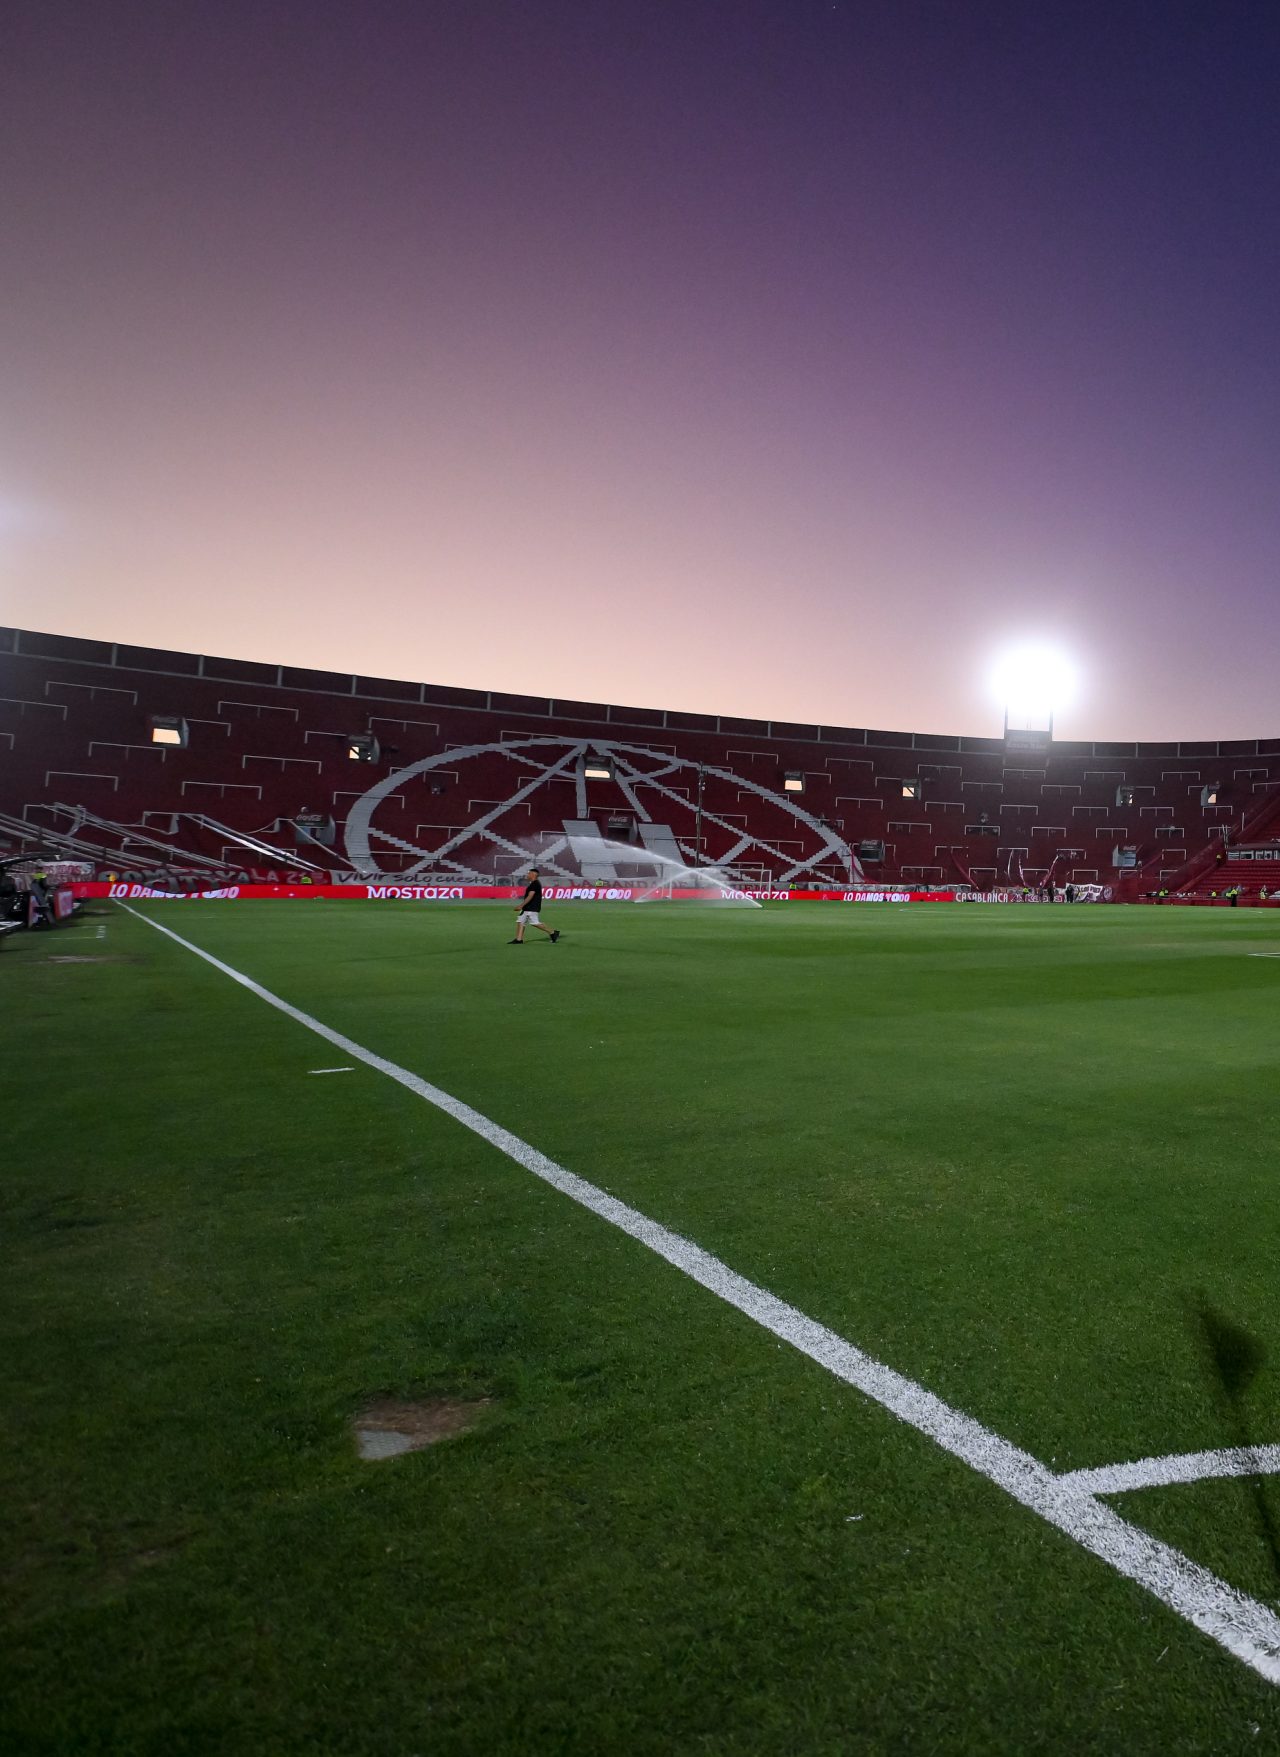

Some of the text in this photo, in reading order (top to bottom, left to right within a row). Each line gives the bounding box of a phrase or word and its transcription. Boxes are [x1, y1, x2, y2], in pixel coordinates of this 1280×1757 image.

[108, 884, 128, 898] LO
[555, 888, 597, 900] DAMOS
[597, 889, 632, 900] TODO
[843, 892, 910, 902] LO DAMOS TODO
[955, 892, 1009, 903] CASABLANCA
